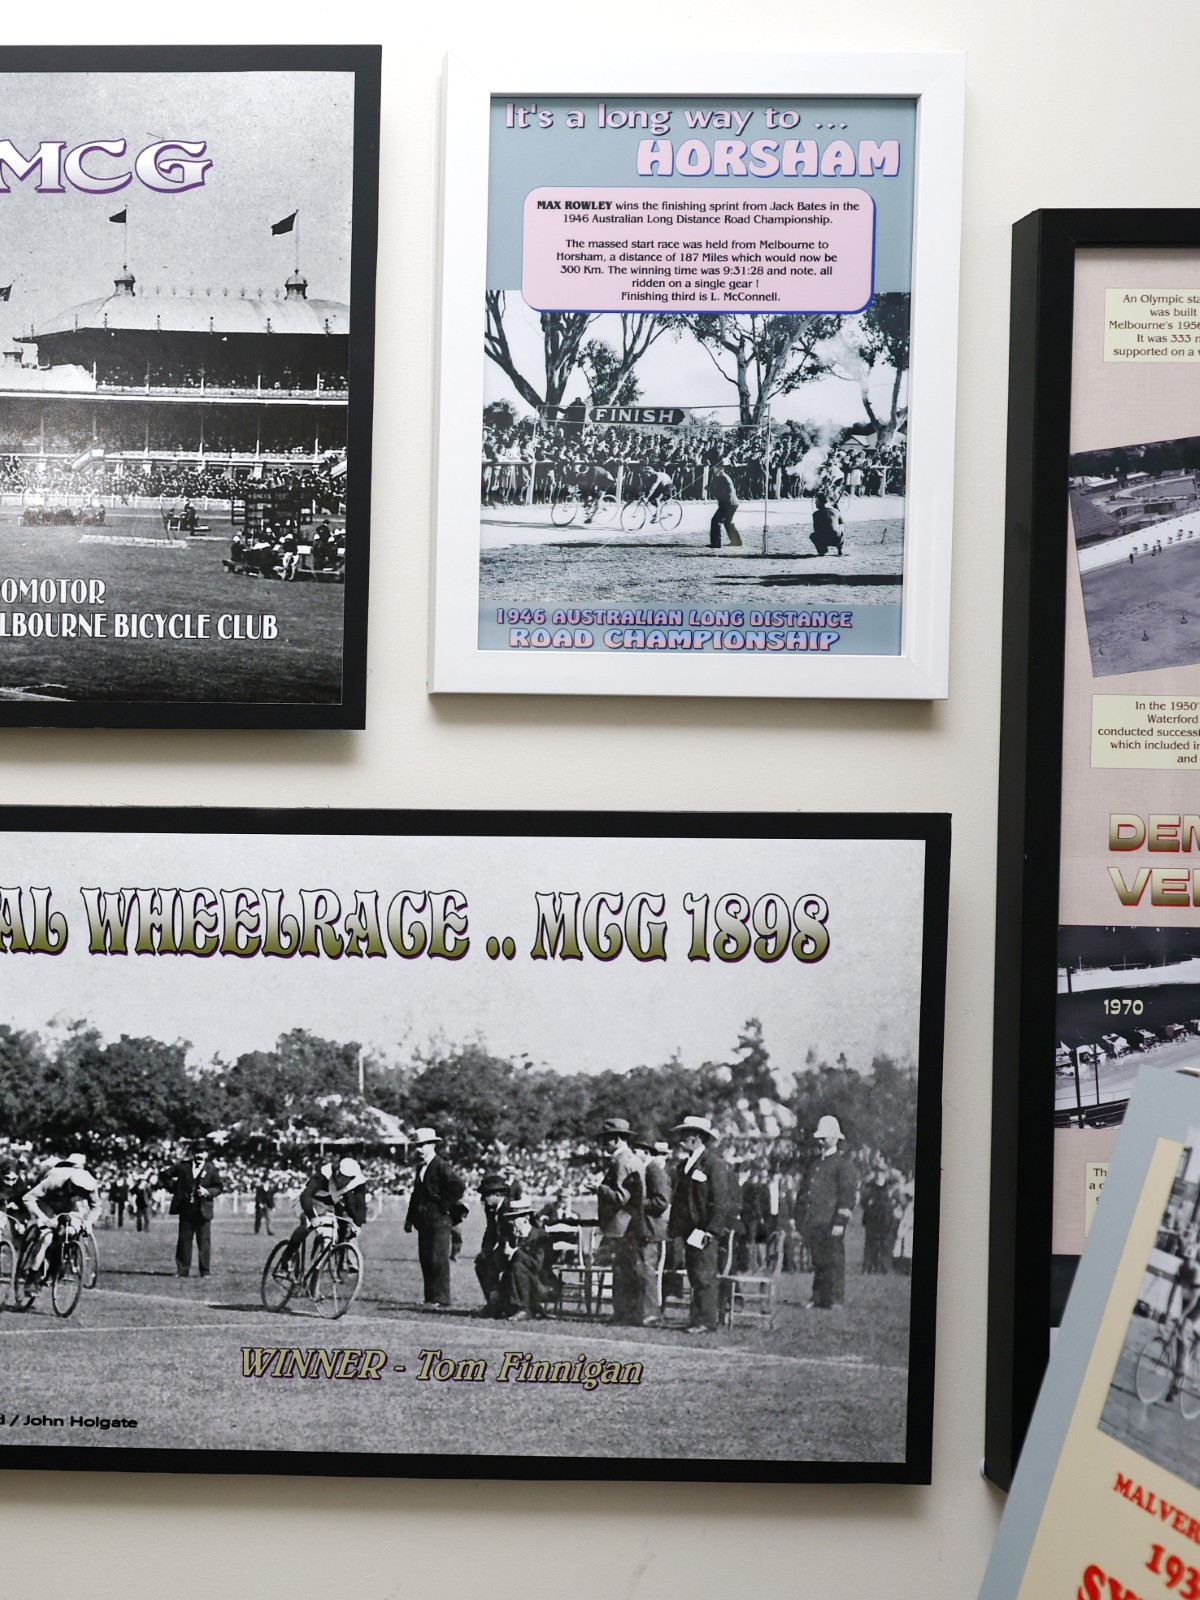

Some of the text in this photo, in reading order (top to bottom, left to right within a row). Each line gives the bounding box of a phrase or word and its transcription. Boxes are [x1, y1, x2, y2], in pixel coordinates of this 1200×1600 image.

[505, 104, 553, 128] It's
[566, 110, 585, 128] a
[598, 104, 672, 136] long
[684, 110, 753, 136] way
[764, 107, 801, 129] to
[637, 139, 901, 178] HORSHAM
[537, 200, 860, 213] MAX ROWLEY wins the finishing sprint from Jack Bates in the
[563, 214, 833, 226] 1946 Australian Long Distance Road Championship.
[566, 239, 585, 249] The
[588, 239, 629, 249] massed
[631, 239, 654, 249] start
[705, 239, 728, 249] held
[731, 239, 756, 249] from
[759, 239, 815, 249] Melbourne
[818, 240, 829, 249] to
[556, 252, 606, 262] Horsham,
[619, 252, 663, 262] distance
[665, 252, 676, 262] of
[680, 252, 699, 262] 187
[702, 252, 729, 262] Miles
[731, 252, 762, 262] which
[765, 252, 796, 262] would
[824, 252, 838, 262] be
[560, 265, 581, 275] 300
[584, 265, 604, 275] Km.
[608, 265, 628, 275] The
[630, 266, 672, 277] winning
[674, 265, 698, 275] time
[723, 265, 764, 275] 9:31:28
[766, 265, 787, 275] and
[790, 267, 817, 276] note,
[819, 265, 833, 275] all
[632, 278, 666, 288] ridden
[694, 279, 726, 290] single
[728, 281, 753, 290] gear
[621, 291, 781, 302] Finishing third is L. McConnell.
[1123, 294, 1137, 303] An
[1140, 294, 1184, 306] Olympic
[1174, 308, 1197, 317] built
[1109, 320, 1174, 330] Melbourne's
[1137, 334, 1144, 343] It
[1147, 335, 1168, 343] was
[1170, 335, 1191, 343] 333
[1113, 348, 1168, 358] supported
[1187, 349, 1195, 357] a
[595, 407, 675, 426] FINISH
[497, 609, 853, 629] 1946 AUSTRALIAN LONG DISTANCE
[114, 611, 210, 640] BICYCLE
[217, 611, 279, 640] CLUB
[509, 629, 840, 651] ROAD CHAMPIONSHIP
[1135, 701, 1200, 711] In the 1950'
[1147, 714, 1199, 724] Waterford
[1098, 727, 1153, 736] conducted
[1110, 740, 1141, 749] which
[1144, 740, 1190, 750] included
[1177, 754, 1198, 763] and
[79, 886, 471, 960] WHEELRACE
[531, 891, 667, 962] MCG
[682, 892, 831, 963] 1898
[1103, 999, 1144, 1015] 1970
[241, 1347, 387, 1380] WINNER
[417, 1350, 487, 1382] Tom
[496, 1352, 644, 1391] Finnigan
[23, 1415, 64, 1427] John
[70, 1415, 138, 1430] Holgate
